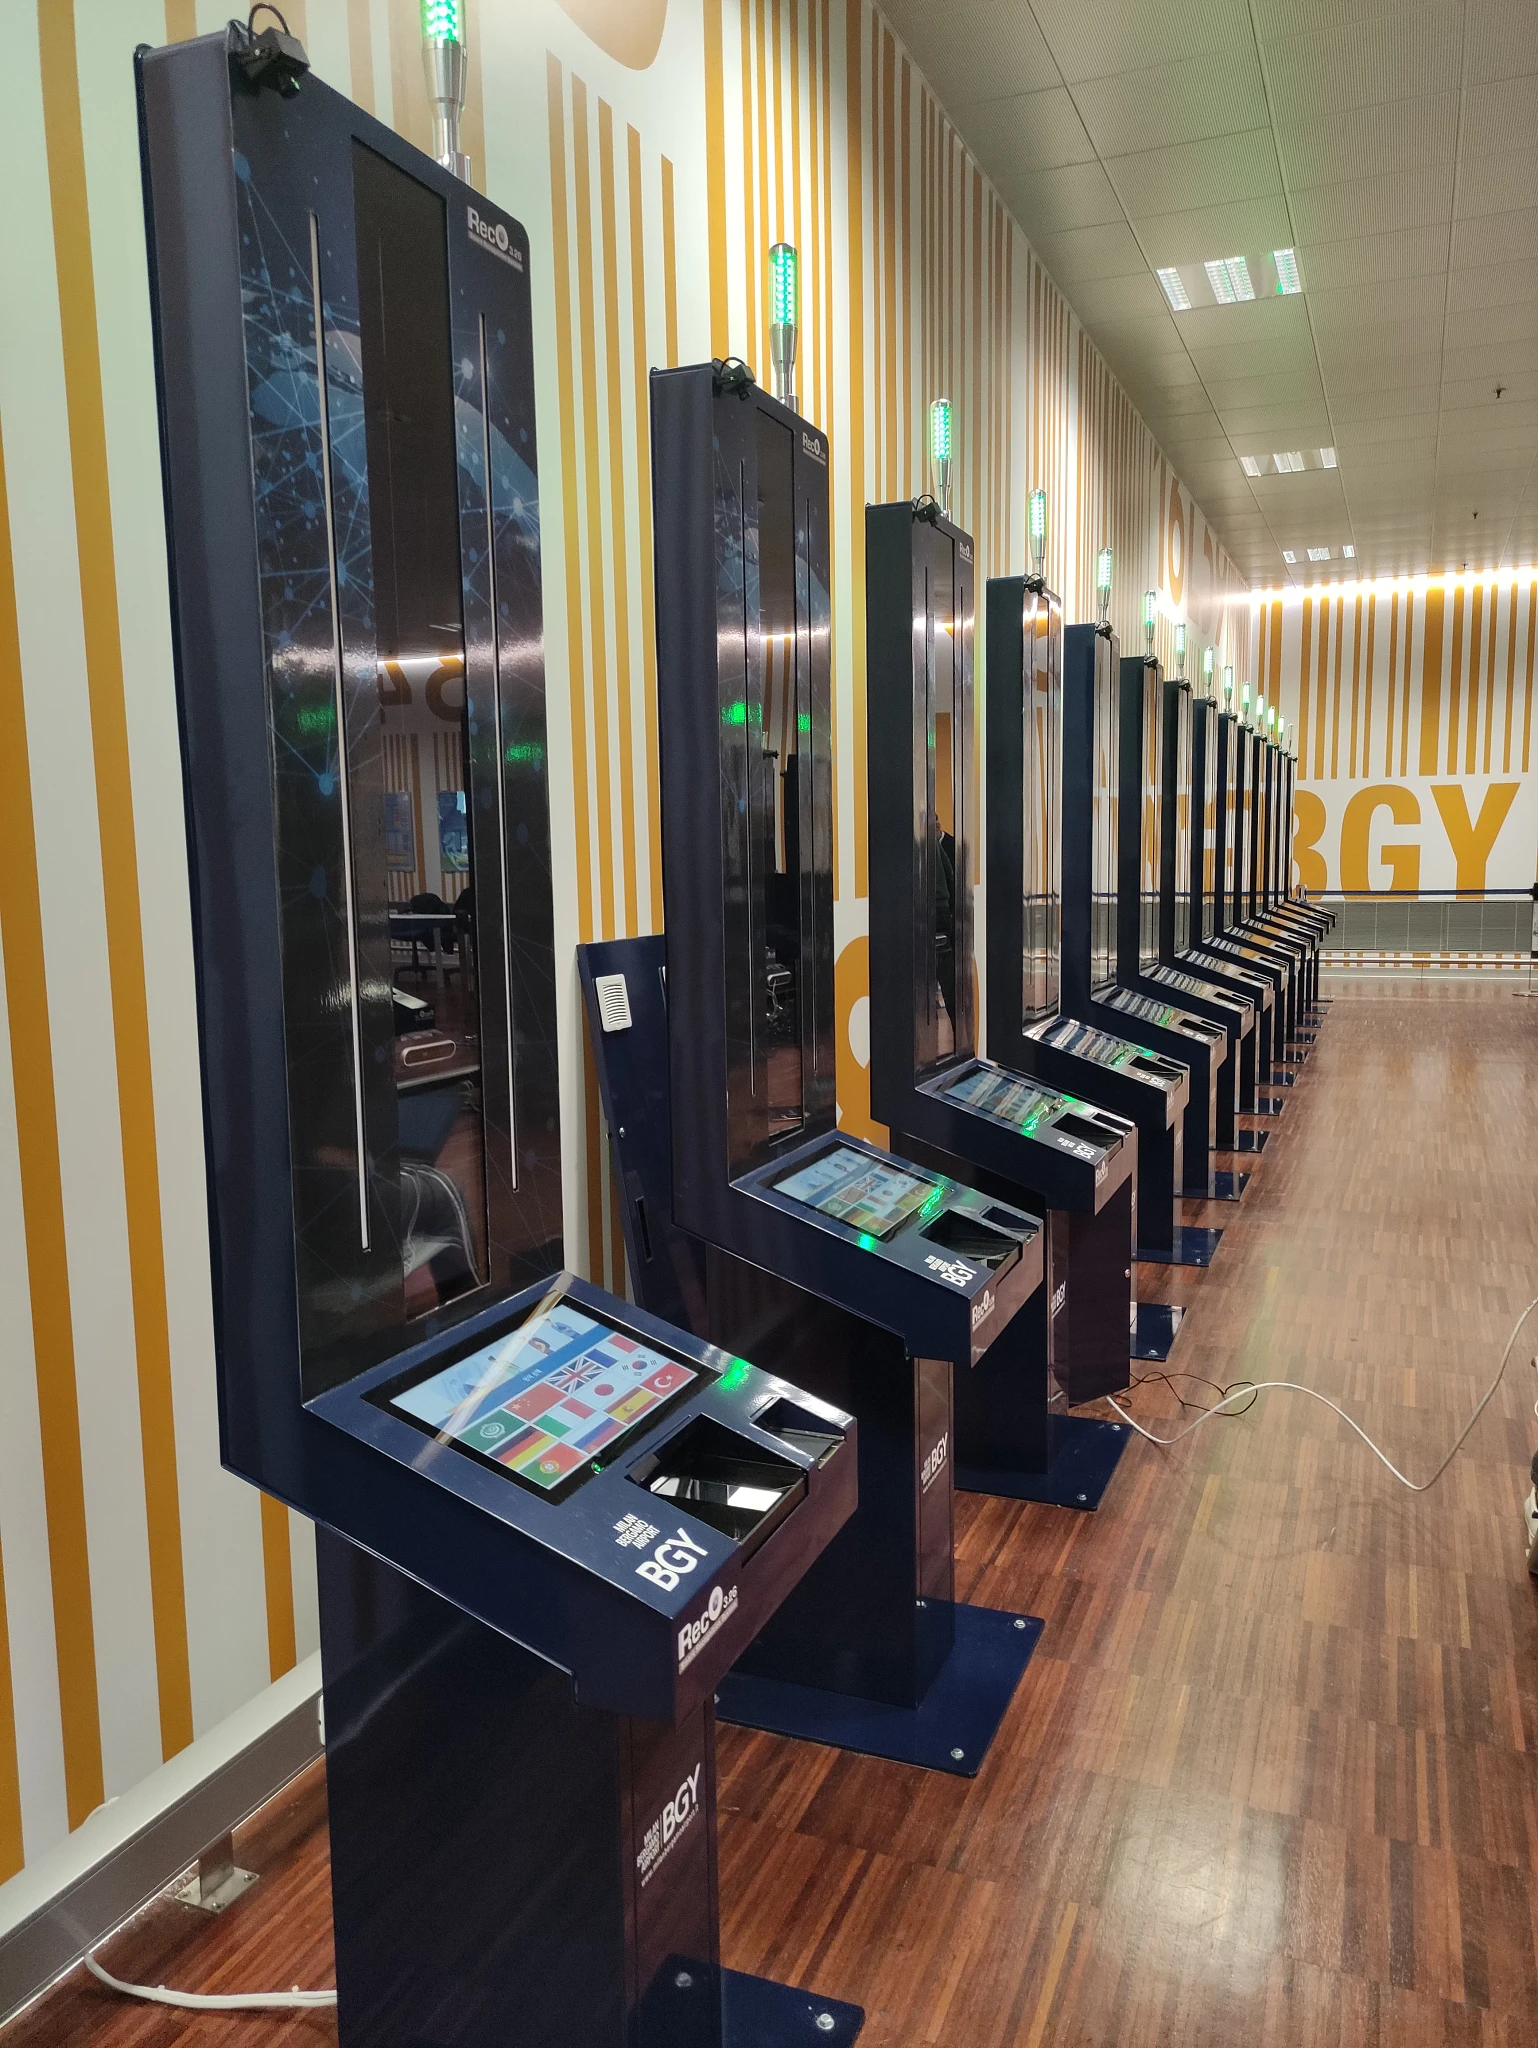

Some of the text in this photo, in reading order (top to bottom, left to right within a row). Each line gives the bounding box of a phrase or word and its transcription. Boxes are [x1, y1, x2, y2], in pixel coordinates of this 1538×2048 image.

[940, 1259, 977, 1287] BGY
[931, 1431, 949, 1474] BGY
[612, 1512, 639, 1533] MILAN
[614, 1519, 649, 1548] BERGAMO
[631, 1524, 661, 1550] AIRPORT
[634, 1527, 709, 1592] BGY
[677, 1585, 723, 1661] RecO
[662, 1761, 701, 1844] BGY
